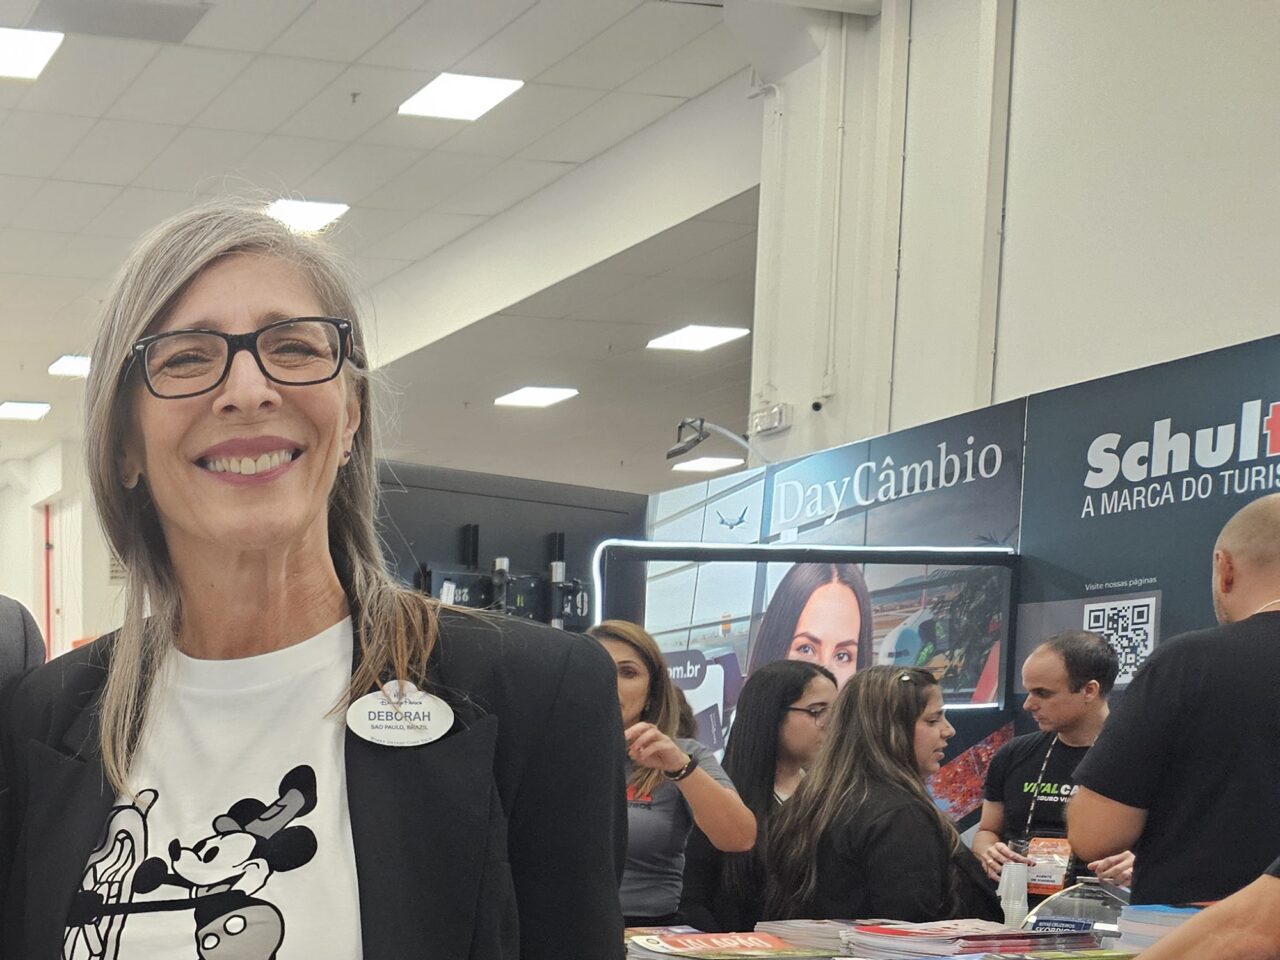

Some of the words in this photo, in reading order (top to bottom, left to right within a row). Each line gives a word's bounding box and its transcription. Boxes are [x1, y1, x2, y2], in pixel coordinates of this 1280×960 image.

[1083, 399, 1280, 489] Schult
[1080, 495, 1095, 519] A
[1100, 481, 1175, 516] MARCA
[1181, 473, 1213, 501] DO
[1219, 463, 1280, 495] TURI
[1084, 583, 1104, 591] Visite
[1104, 581, 1128, 589] nossas
[1128, 577, 1157, 587] páginas
[368, 710, 431, 722] DEBORAH
